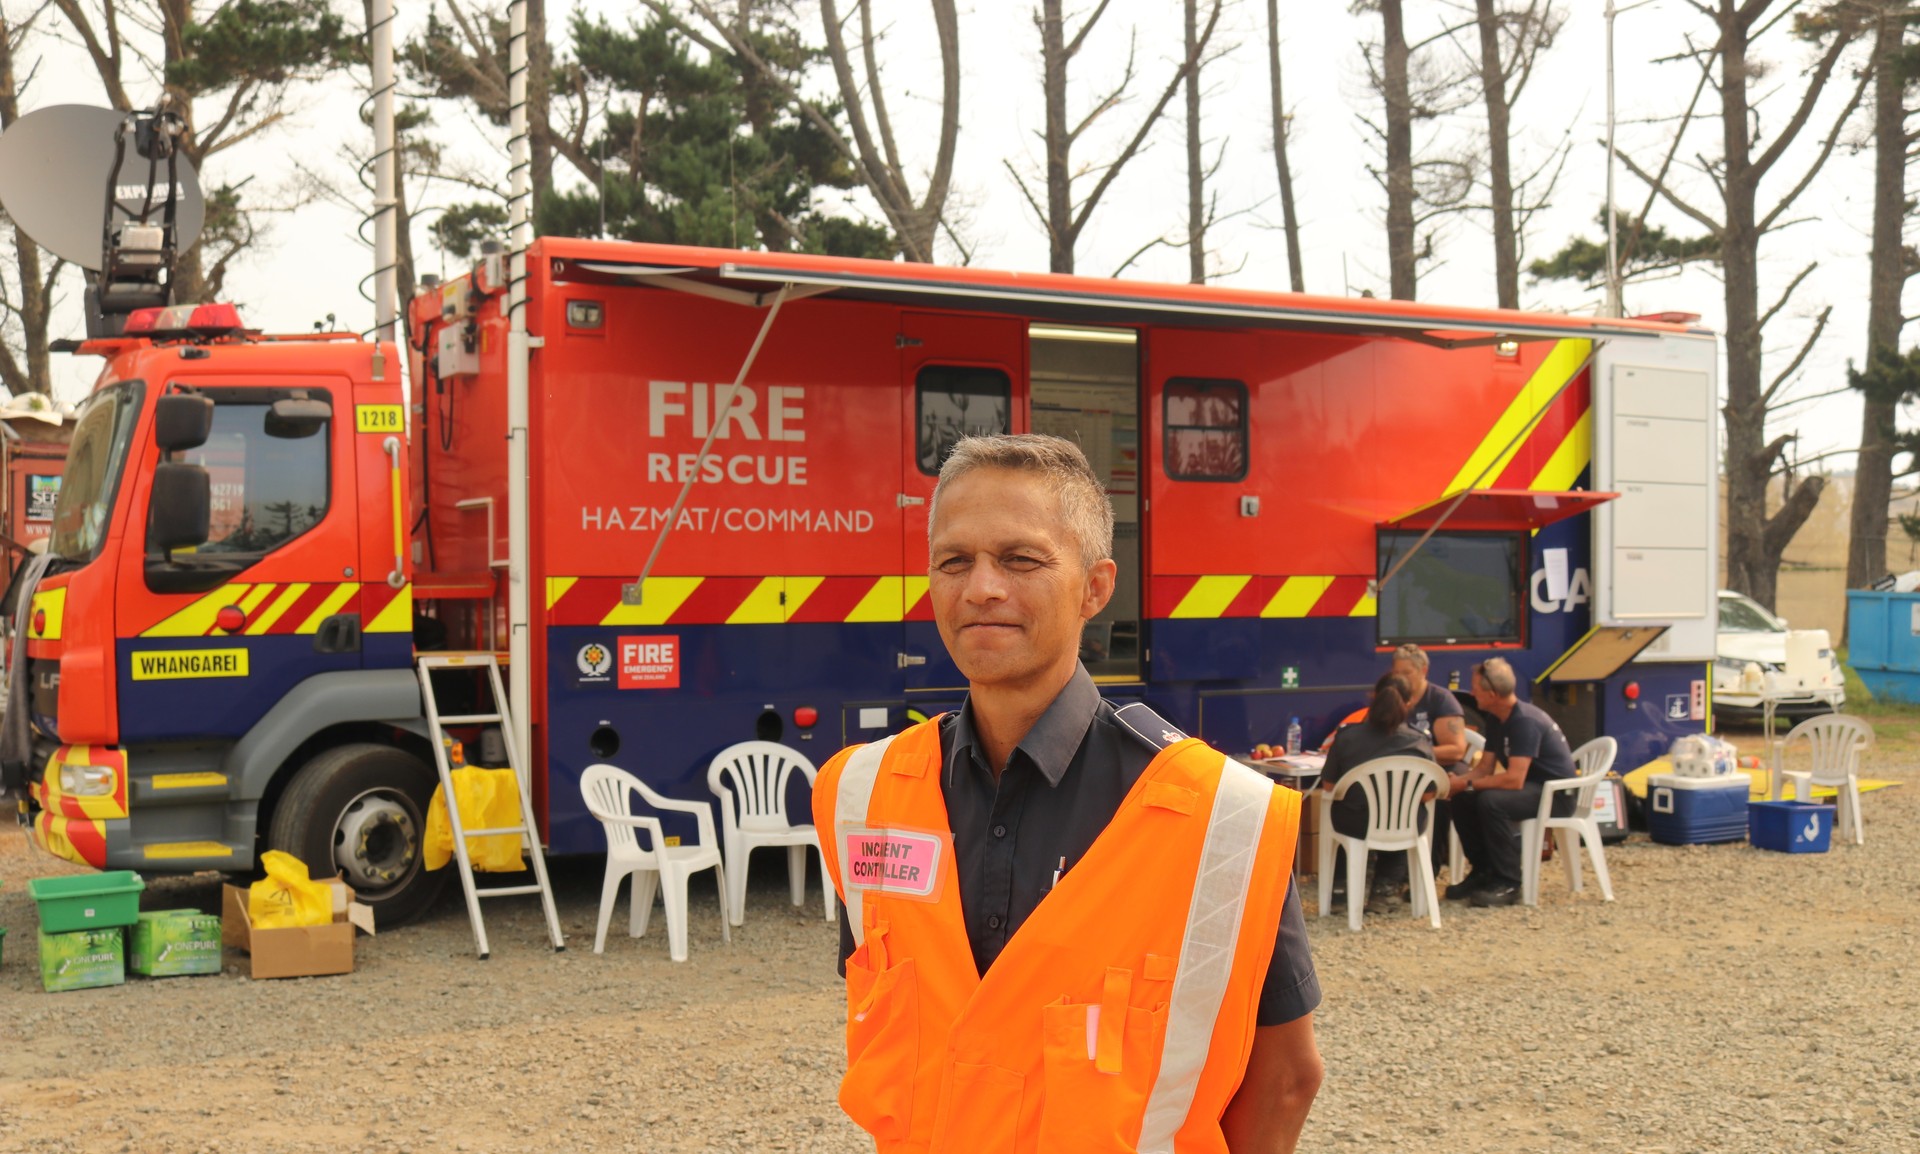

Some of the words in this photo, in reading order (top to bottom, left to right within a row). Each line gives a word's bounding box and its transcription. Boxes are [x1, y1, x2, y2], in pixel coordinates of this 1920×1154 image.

[362, 411, 397, 426] 1218
[648, 380, 806, 442] FIRE
[648, 452, 808, 485] RESCUE
[581, 506, 874, 534] HAZMAT/COMMAND
[623, 643, 674, 665] FIRE
[141, 655, 237, 675] WHANGAREI
[623, 664, 674, 674] EMERGENCY
[861, 841, 913, 860] INCIENT
[853, 861, 920, 882] CONTLLER
